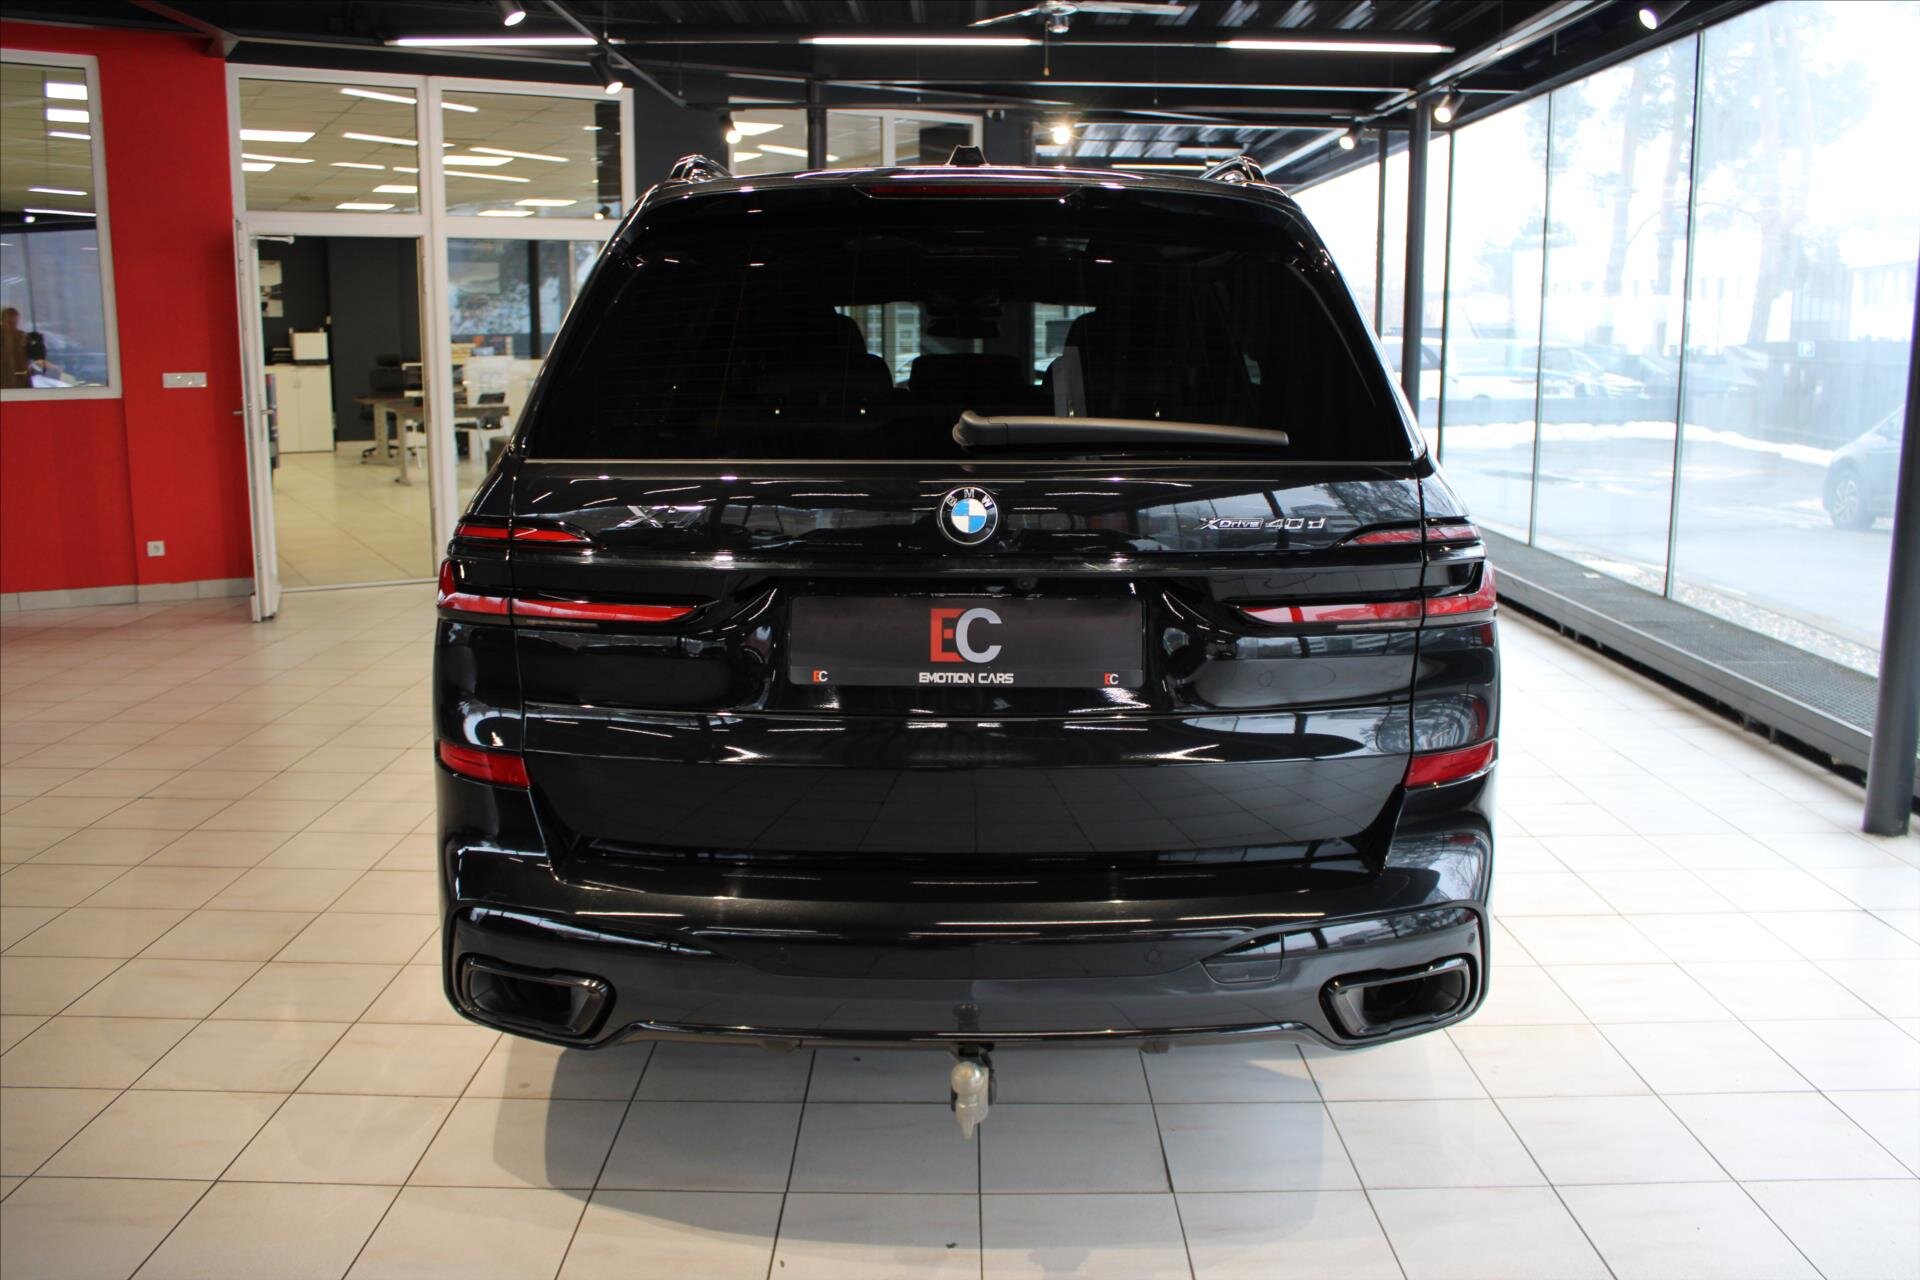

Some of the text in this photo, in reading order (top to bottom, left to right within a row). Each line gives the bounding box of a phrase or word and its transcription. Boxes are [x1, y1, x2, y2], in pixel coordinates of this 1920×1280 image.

[946, 488, 992, 508] BMW
[930, 607, 1002, 663] EC
[812, 670, 828, 682] EC
[918, 672, 1014, 683] EMOTION CARS
